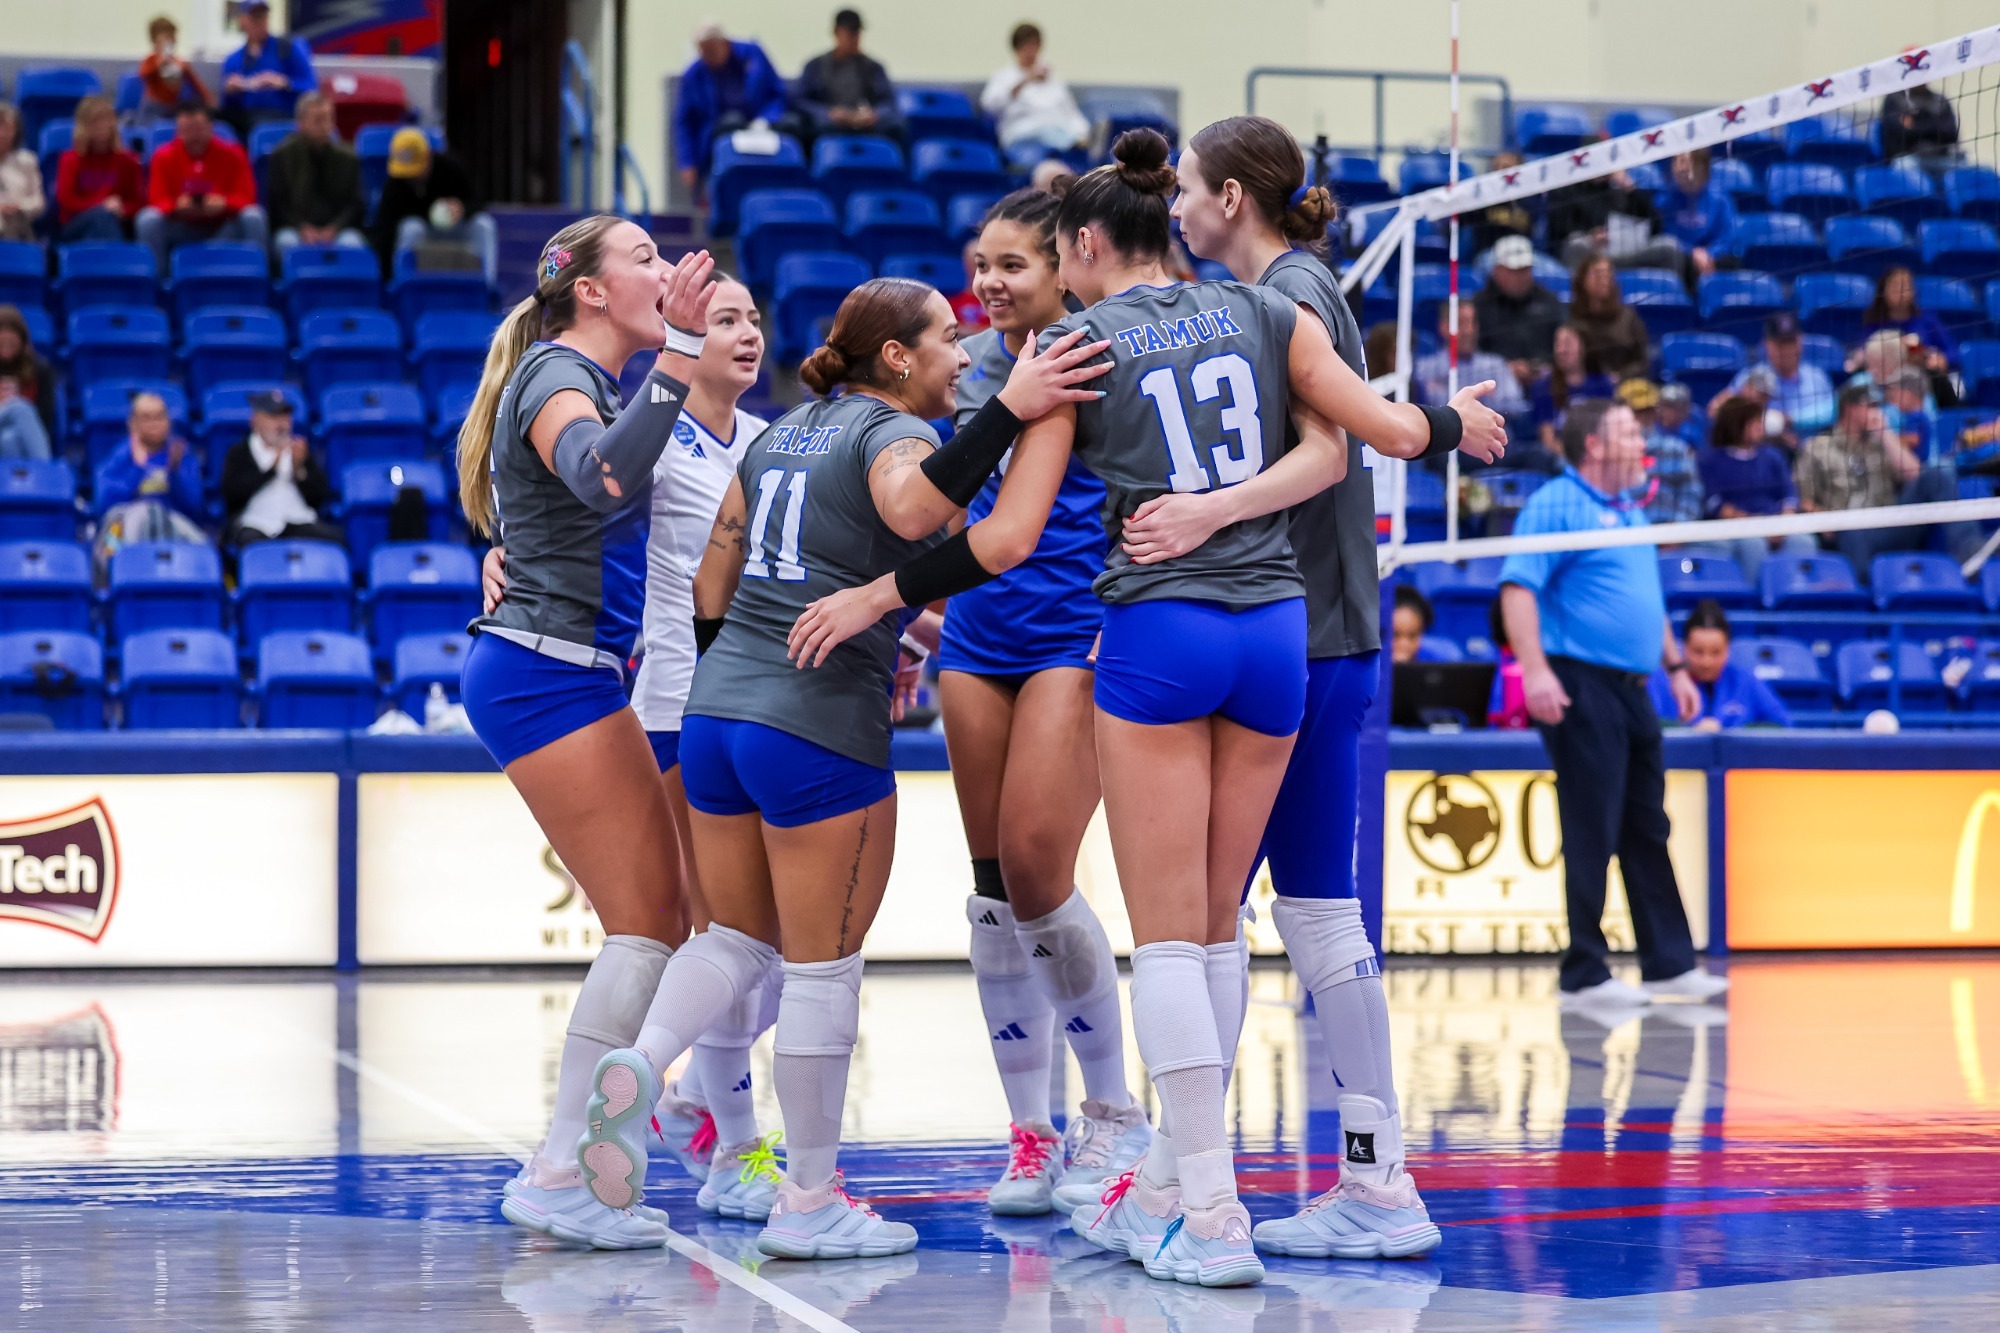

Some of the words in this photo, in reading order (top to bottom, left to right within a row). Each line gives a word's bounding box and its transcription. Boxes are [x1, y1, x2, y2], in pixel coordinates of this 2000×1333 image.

[1115, 305, 1243, 357] TAMUK
[1139, 352, 1264, 493] 13
[743, 466, 810, 582] 11
[0, 843, 98, 893] Tech
[1388, 922, 1463, 952] EST
[1482, 922, 1624, 952] TEXS
